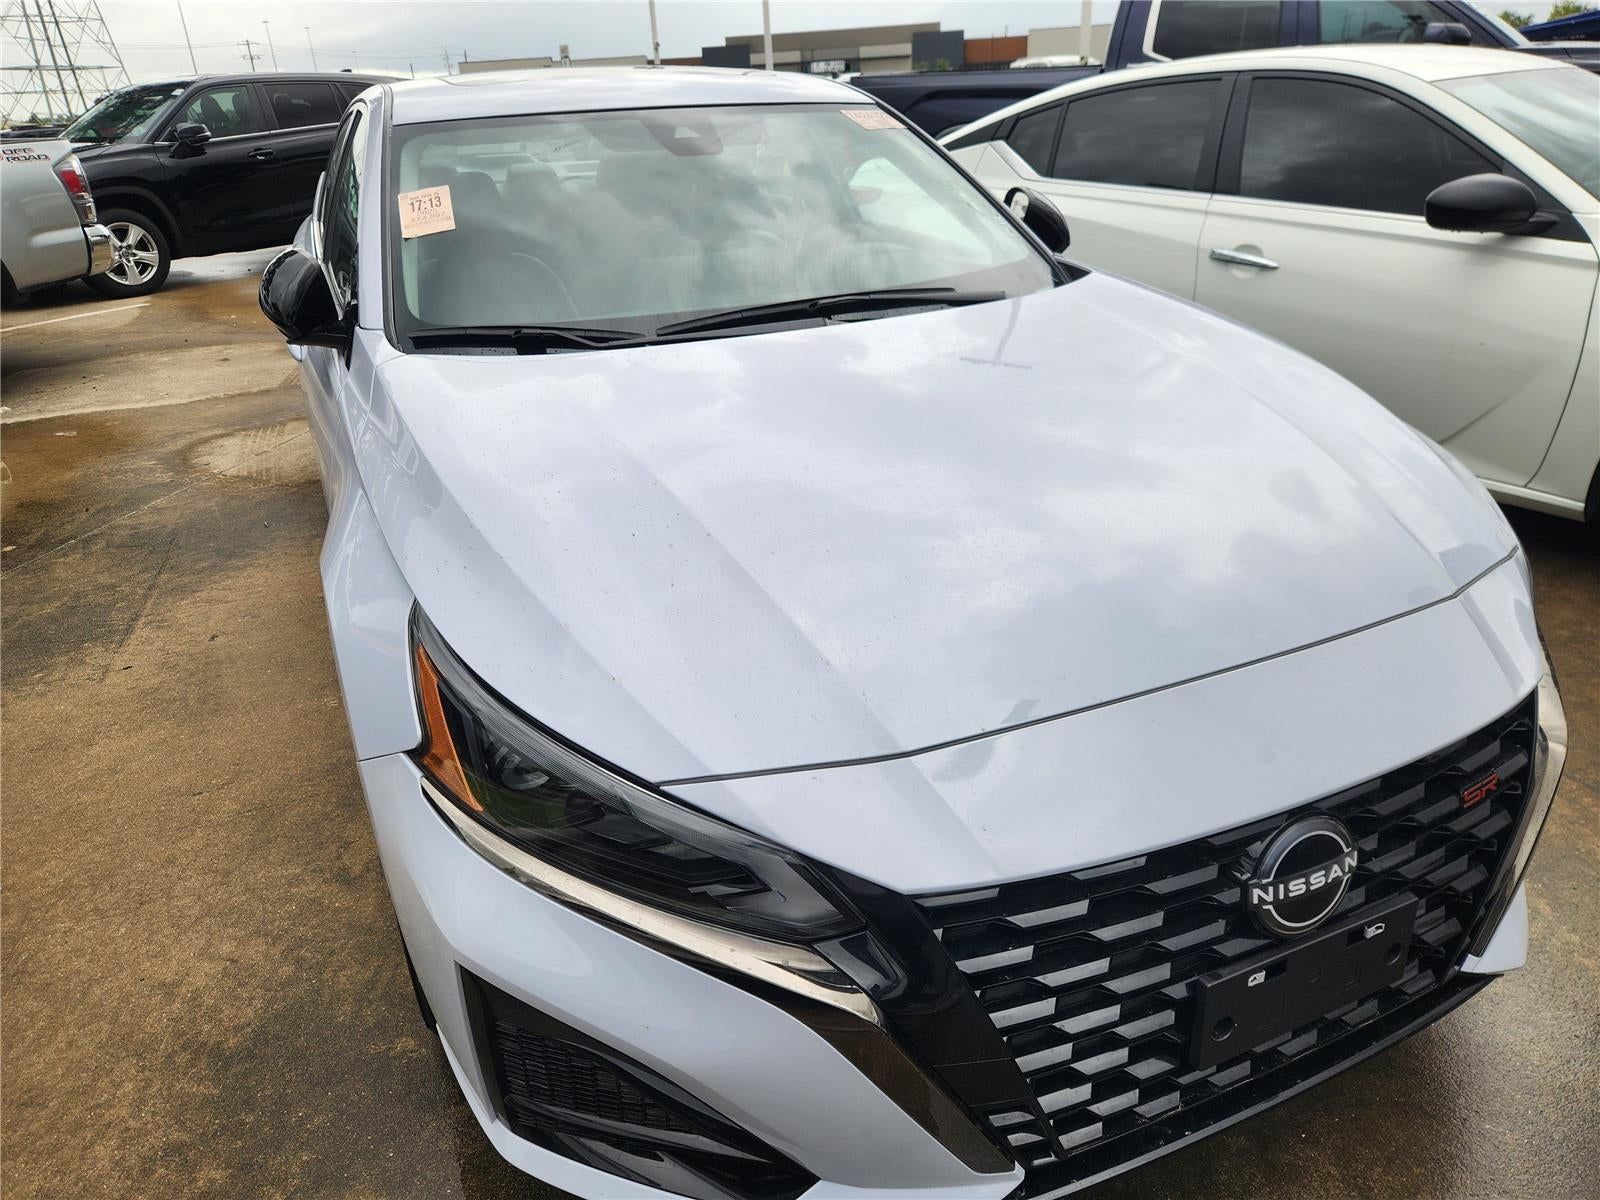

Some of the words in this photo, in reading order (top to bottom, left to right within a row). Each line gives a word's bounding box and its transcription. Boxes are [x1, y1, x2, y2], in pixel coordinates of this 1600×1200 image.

[1, 147, 34, 155] OFF
[5, 154, 50, 163] ROAD
[410, 195, 442, 213] 17:13
[1463, 772, 1498, 808] SR
[1252, 850, 1358, 904] NISSAN
